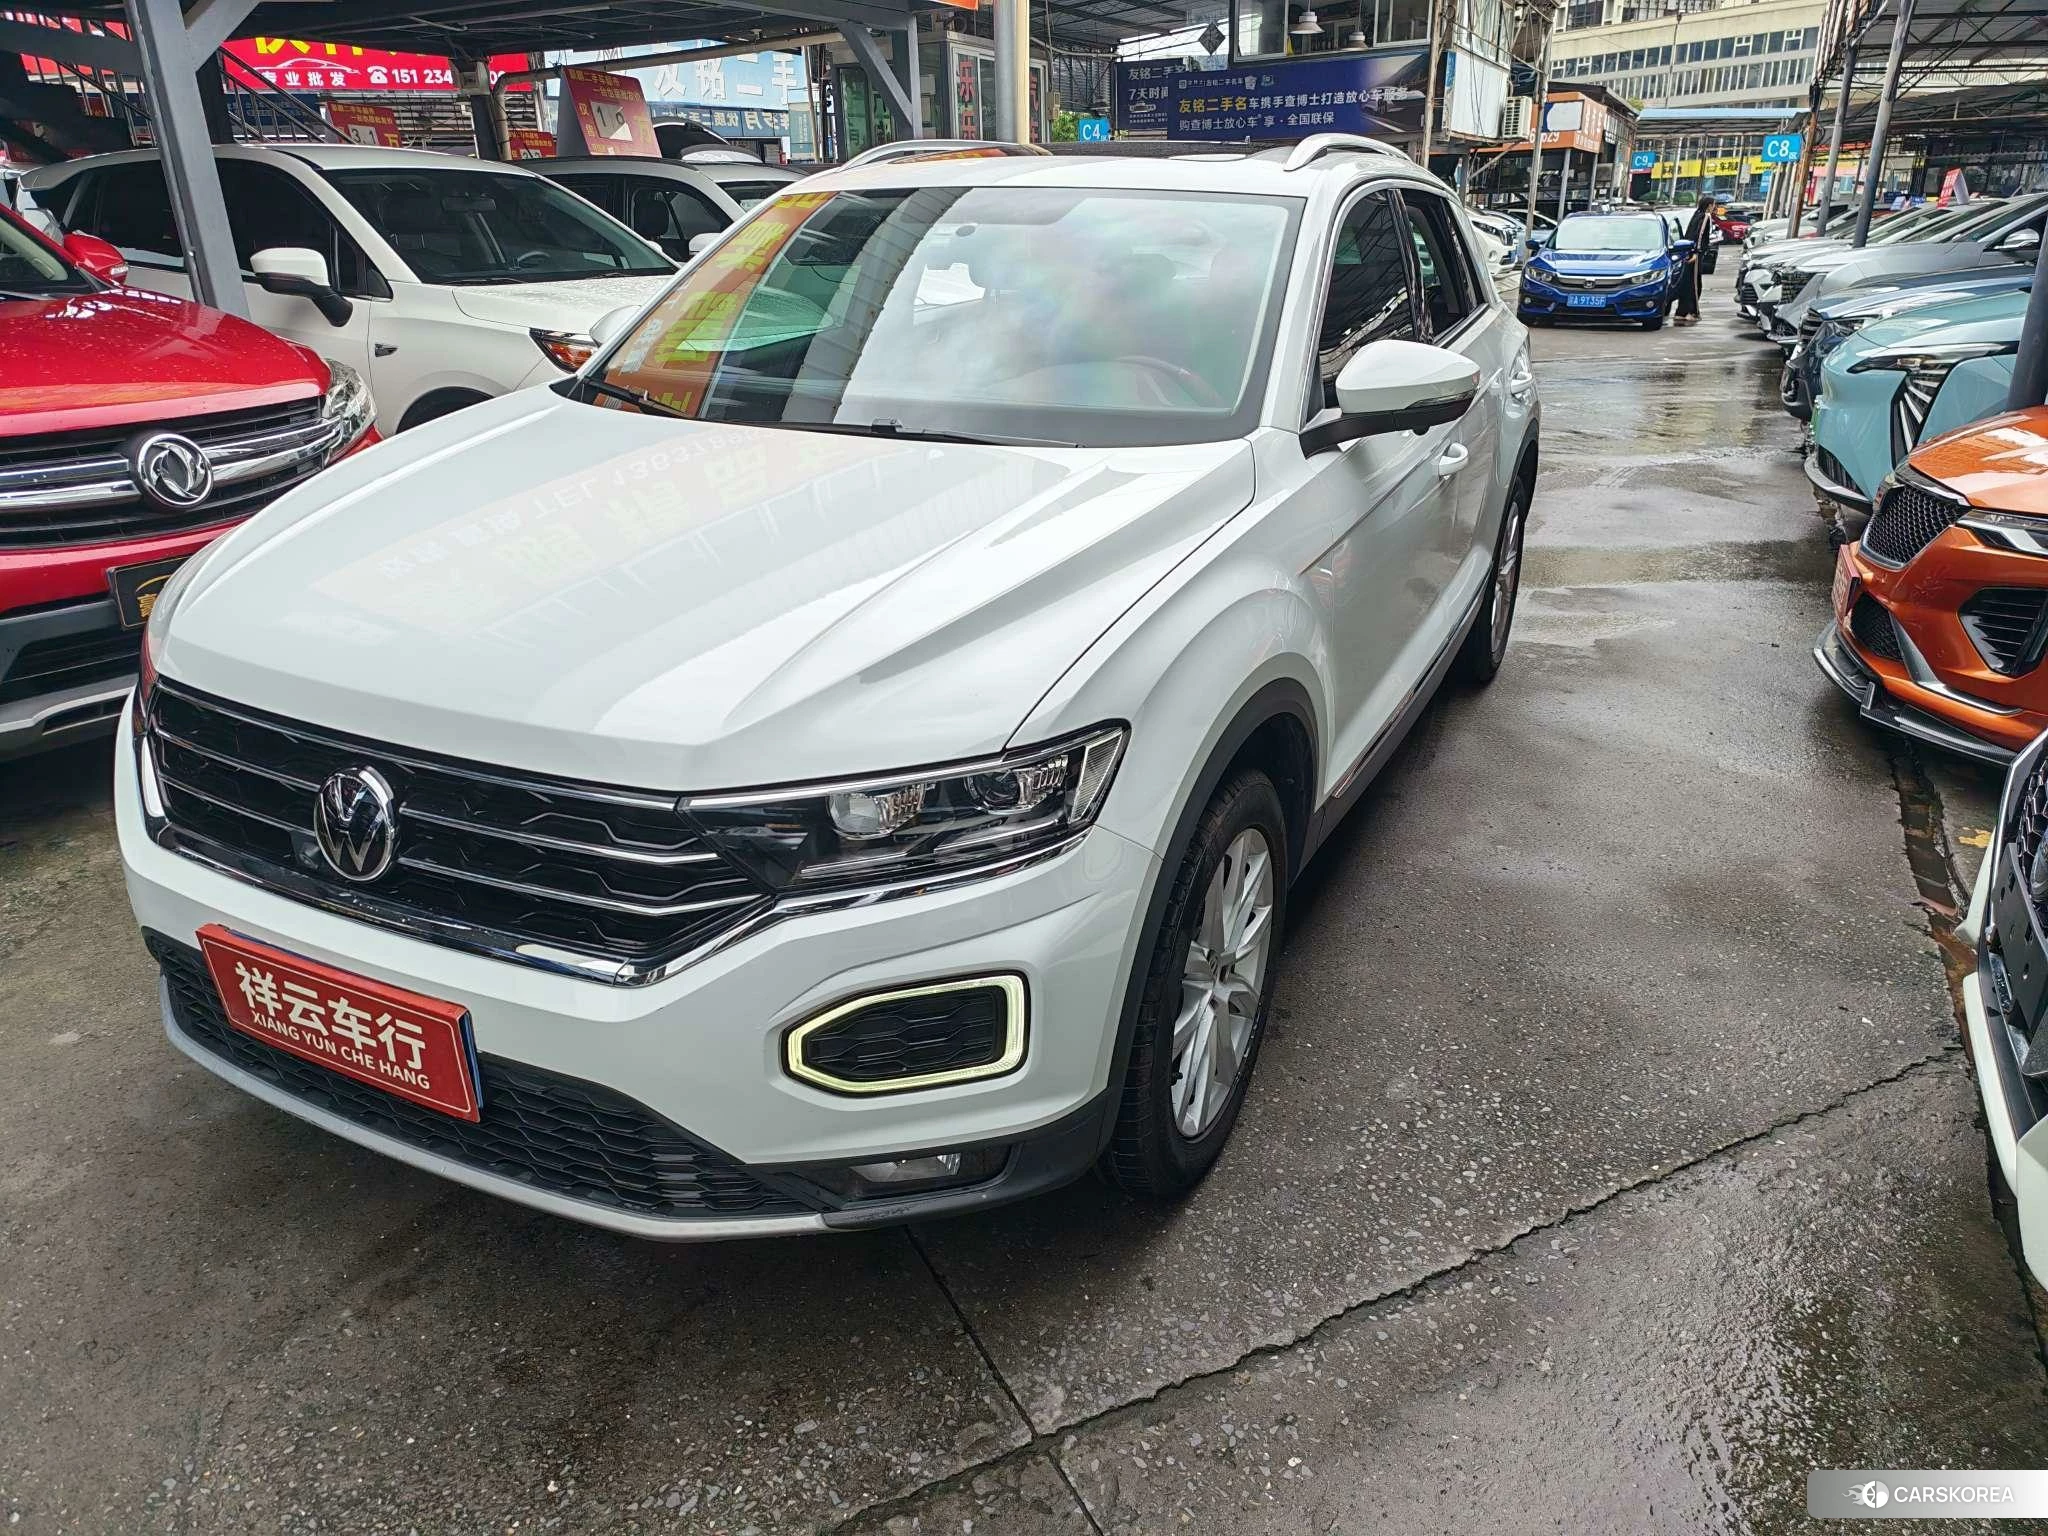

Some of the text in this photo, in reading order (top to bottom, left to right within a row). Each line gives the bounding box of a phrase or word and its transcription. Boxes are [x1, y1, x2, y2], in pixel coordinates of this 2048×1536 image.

[391, 69, 418, 84] 151
[235, 961, 426, 1070] 祥云车行
[251, 1010, 431, 1090] XIANG YUN CHE HANG
